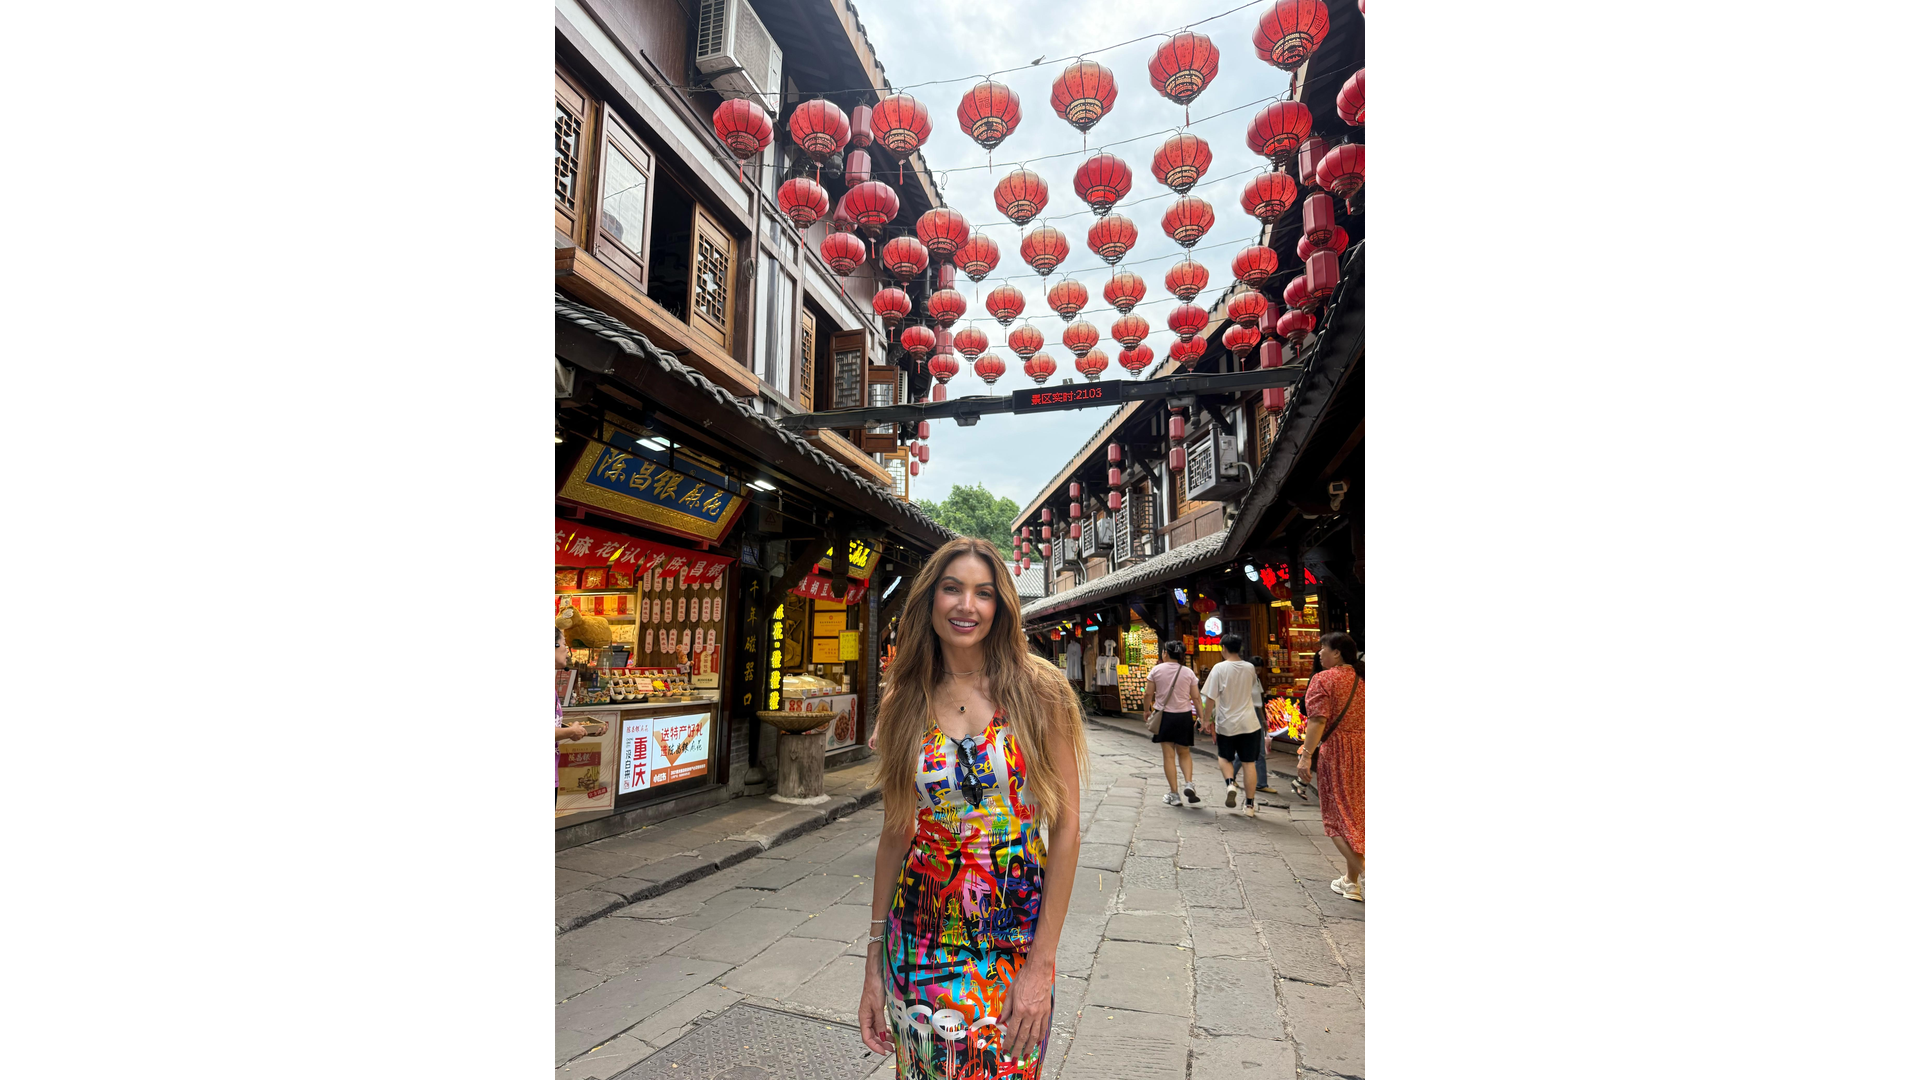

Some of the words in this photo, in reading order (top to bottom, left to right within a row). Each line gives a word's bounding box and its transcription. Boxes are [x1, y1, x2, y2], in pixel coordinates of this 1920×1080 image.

[1031, 388, 1102, 405] 景区实时:2103
[597, 447, 726, 516] 陈昌银麻花
[743, 580, 760, 706] 千年磁器口
[660, 722, 703, 743] 送特产好礼
[631, 736, 648, 788] 重庆
